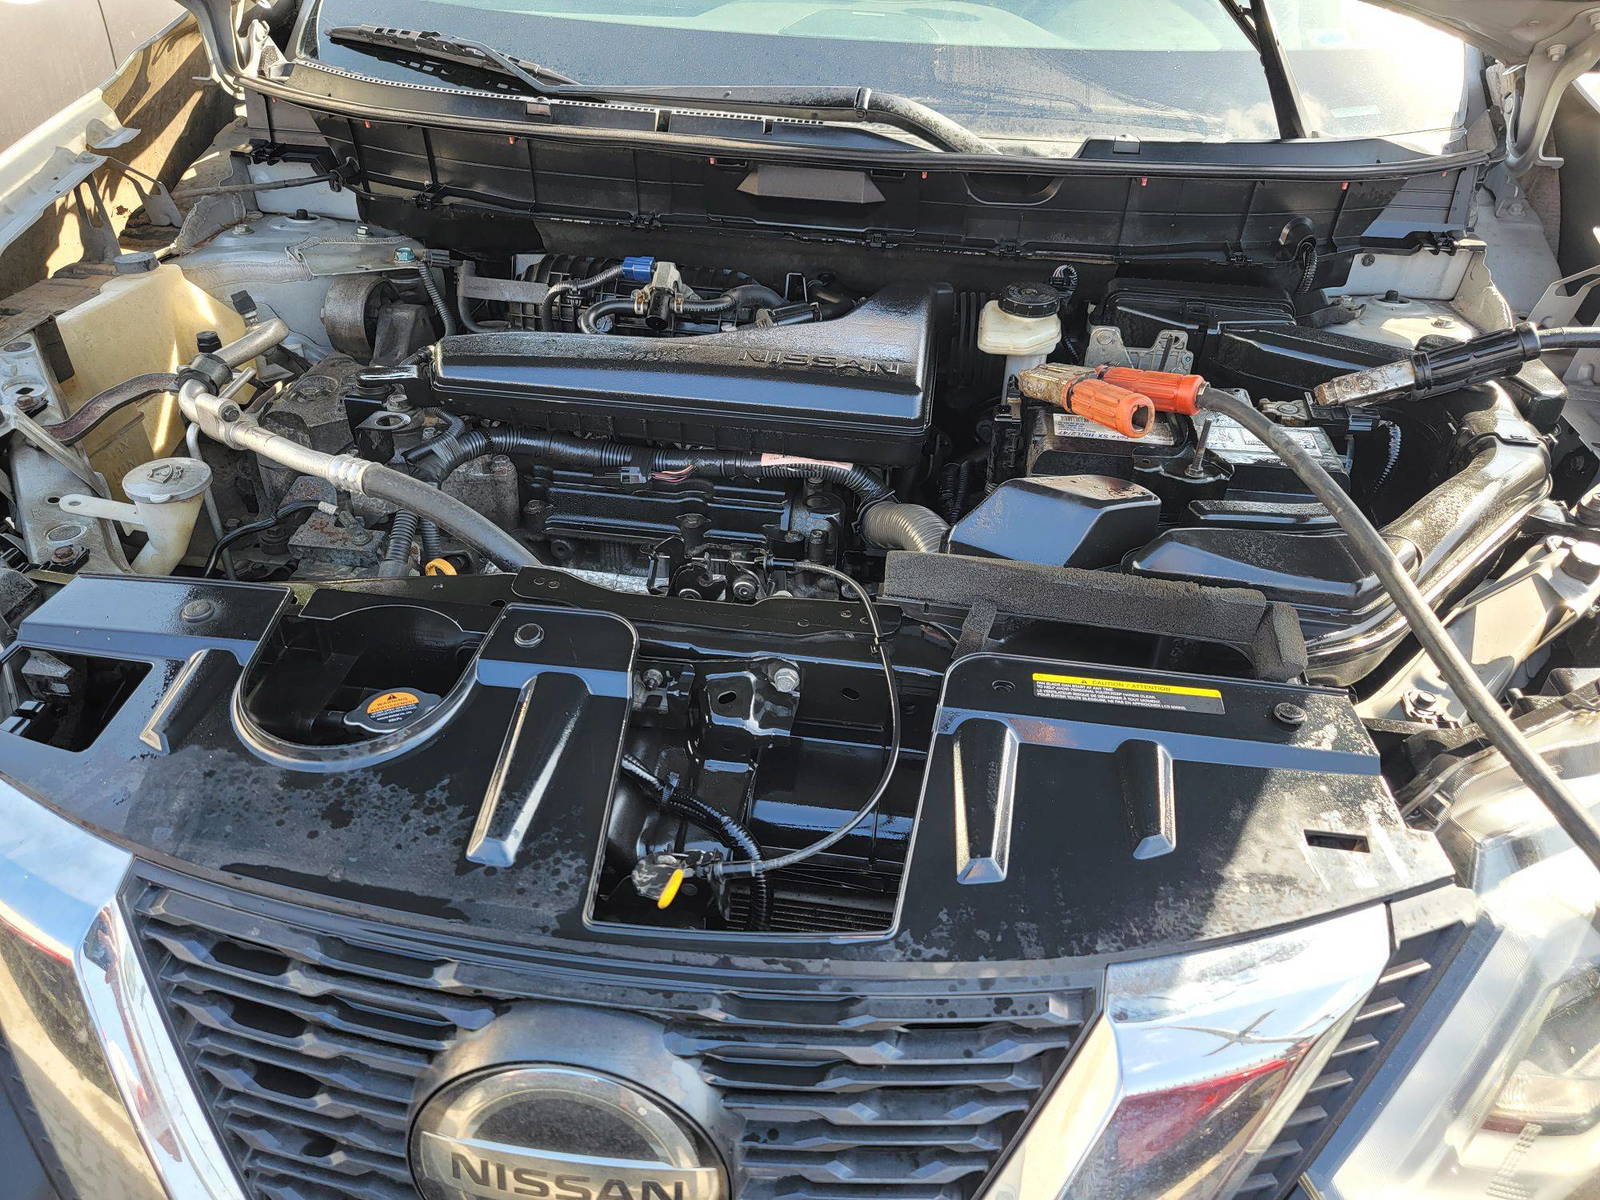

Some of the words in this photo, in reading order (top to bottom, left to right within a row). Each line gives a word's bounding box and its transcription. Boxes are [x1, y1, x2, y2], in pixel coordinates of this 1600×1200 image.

[739, 350, 899, 376] NISSAN
[1132, 684, 1172, 692] ATTENTION
[451, 1152, 684, 1200] NISSAN
